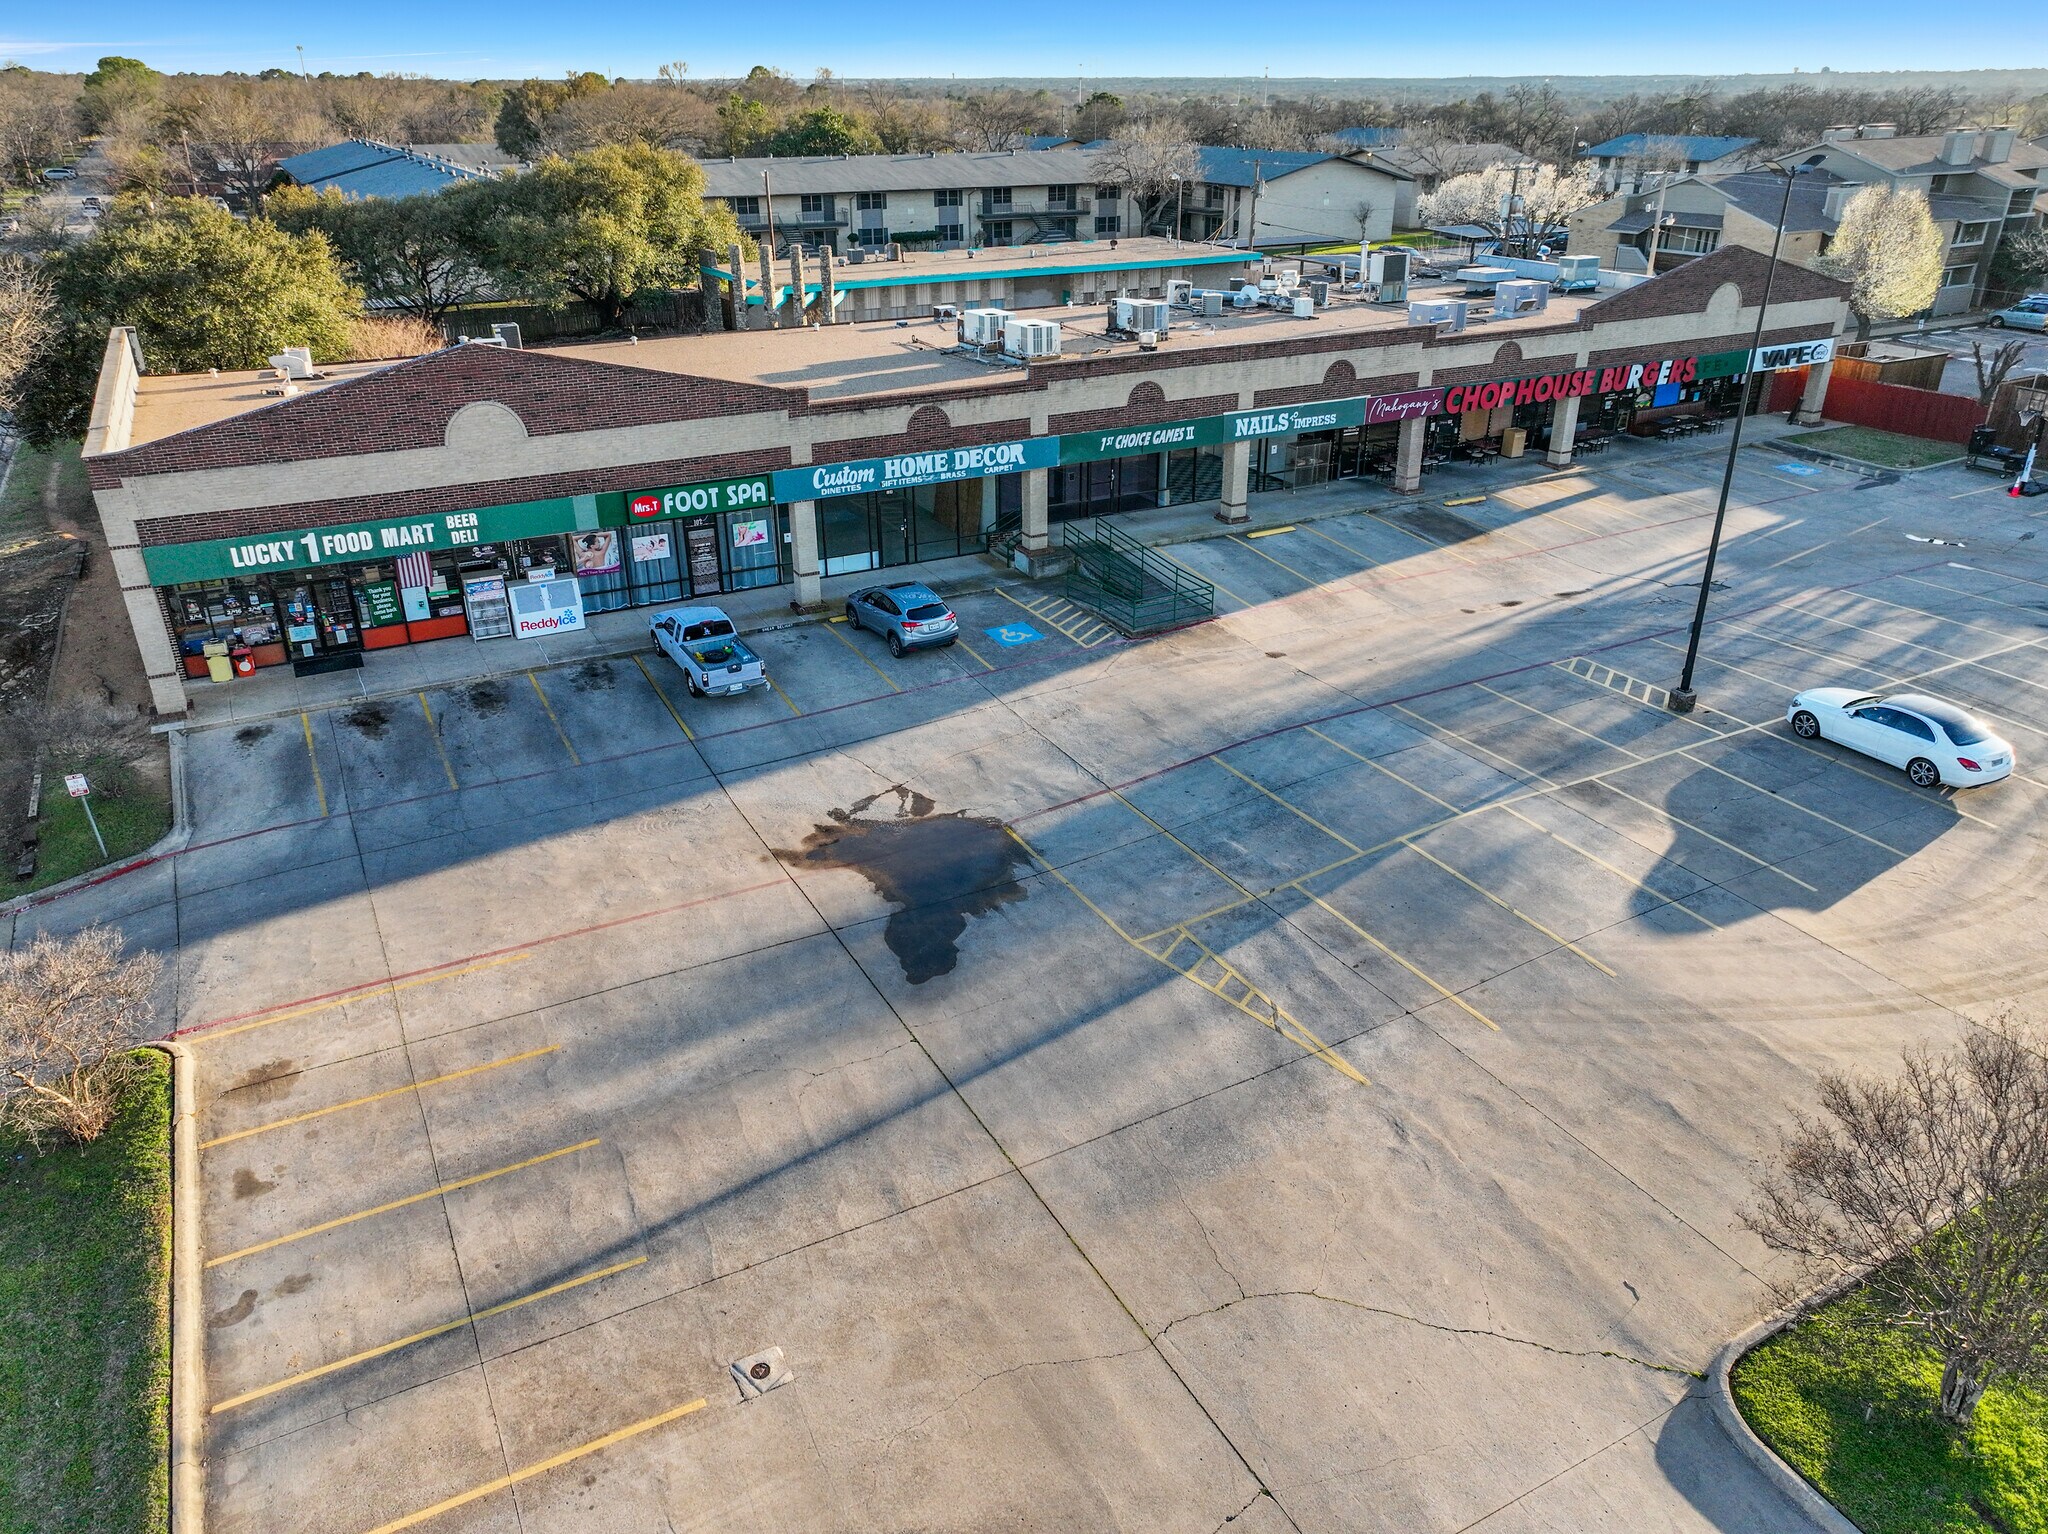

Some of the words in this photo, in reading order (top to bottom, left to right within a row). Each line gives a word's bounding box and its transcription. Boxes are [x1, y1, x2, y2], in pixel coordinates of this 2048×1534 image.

[1762, 346, 1812, 368] VAPE
[1446, 370, 1597, 414] CHOPHOUSE
[1600, 357, 1698, 393] BURGERS
[1368, 394, 1440, 422] Mahogany's
[1115, 432, 1152, 449] CHOICE
[1152, 427, 1185, 444] GAMES
[1186, 426, 1195, 440] II
[1235, 412, 1289, 437] NAILS
[1294, 414, 1336, 429] IMPRESS
[812, 465, 875, 489] Custom
[884, 453, 948, 479] HOME
[953, 443, 1026, 470] DECOR
[821, 484, 862, 496] DINETTES
[898, 476, 922, 485] ITEMS
[940, 470, 966, 480] BRASS
[984, 464, 1014, 474] CARPET
[664, 487, 719, 514] FOOT
[726, 482, 766, 506] SPA
[446, 513, 478, 529] BEER
[230, 540, 294, 568] LUCKY
[300, 532, 320, 563] 1
[322, 531, 373, 555] FOOD
[381, 523, 434, 548] MART
[451, 529, 478, 544] DELI
[520, 614, 577, 631] ReddyIce
